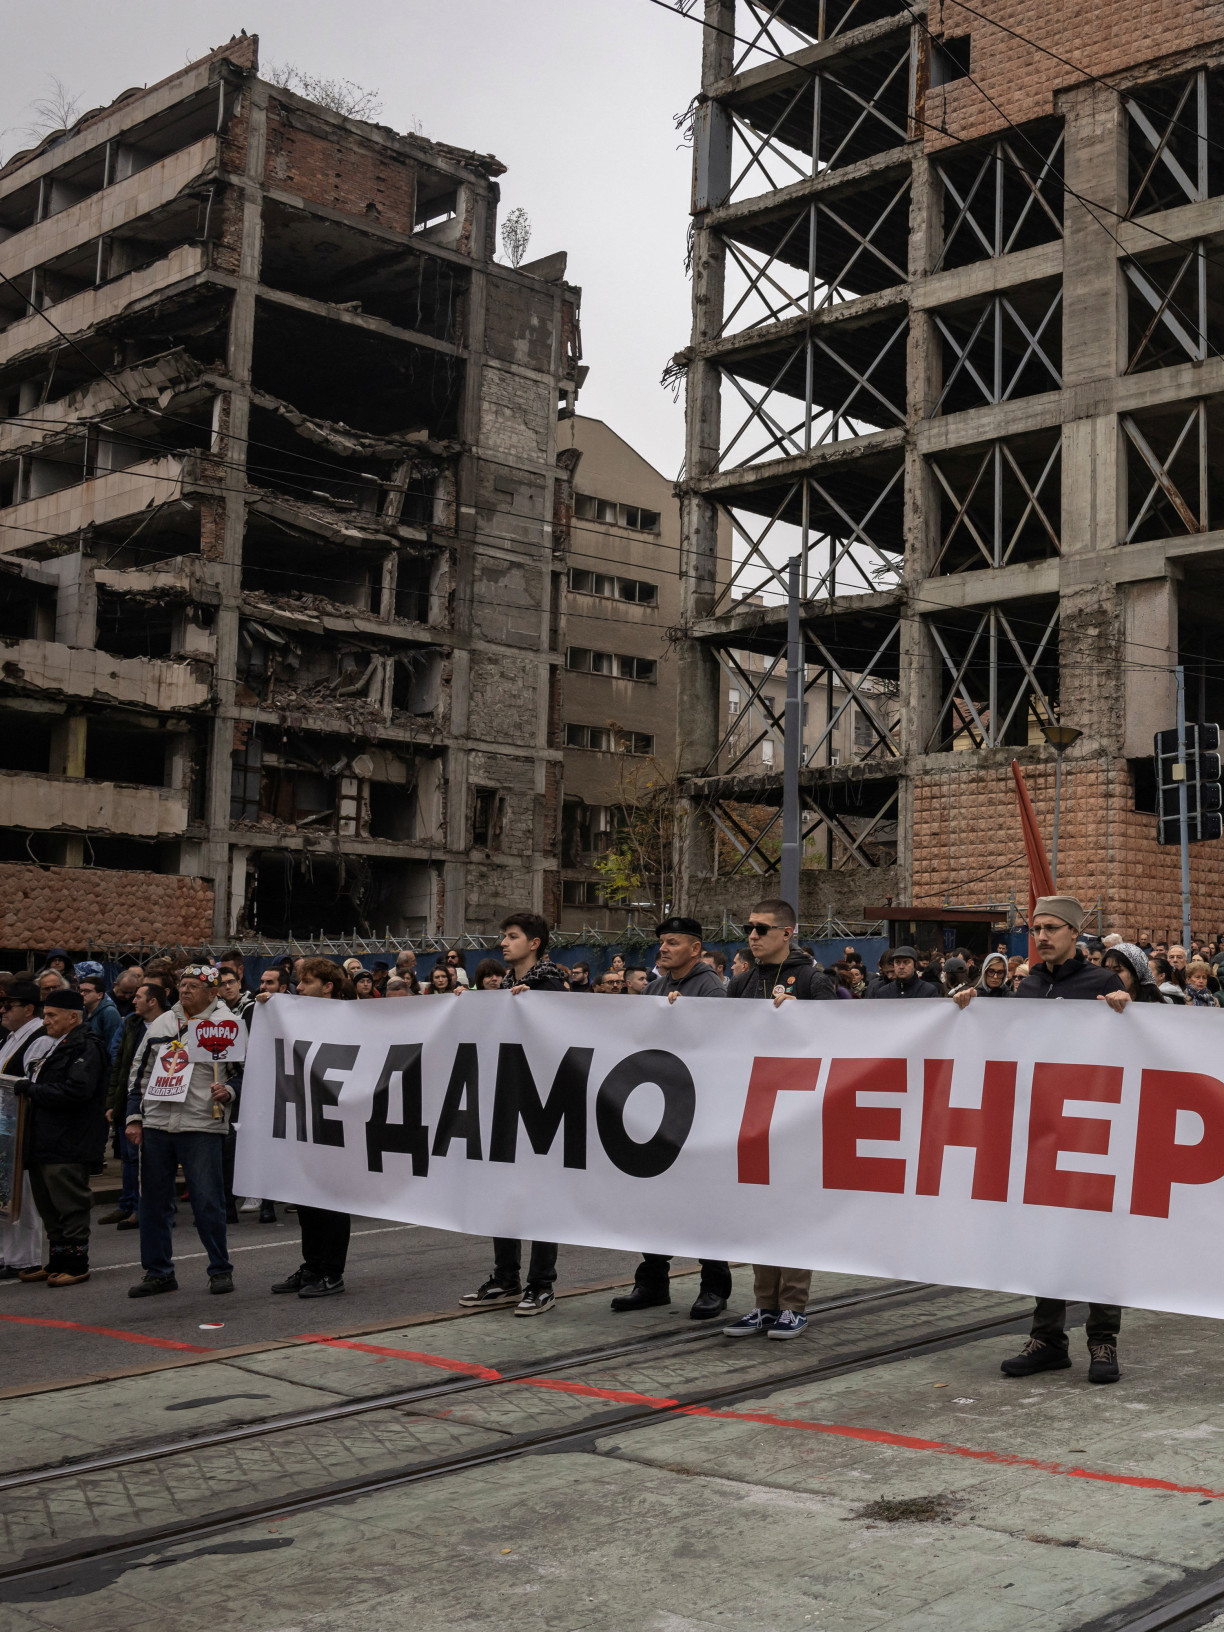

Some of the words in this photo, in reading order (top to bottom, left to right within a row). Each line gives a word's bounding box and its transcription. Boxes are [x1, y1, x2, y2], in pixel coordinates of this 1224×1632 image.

[197, 1026, 237, 1040] PUMPAJ
[155, 1075, 184, 1087] НИСИ
[272, 1038, 360, 1147] НЕ
[365, 1043, 695, 1178] ДАМО
